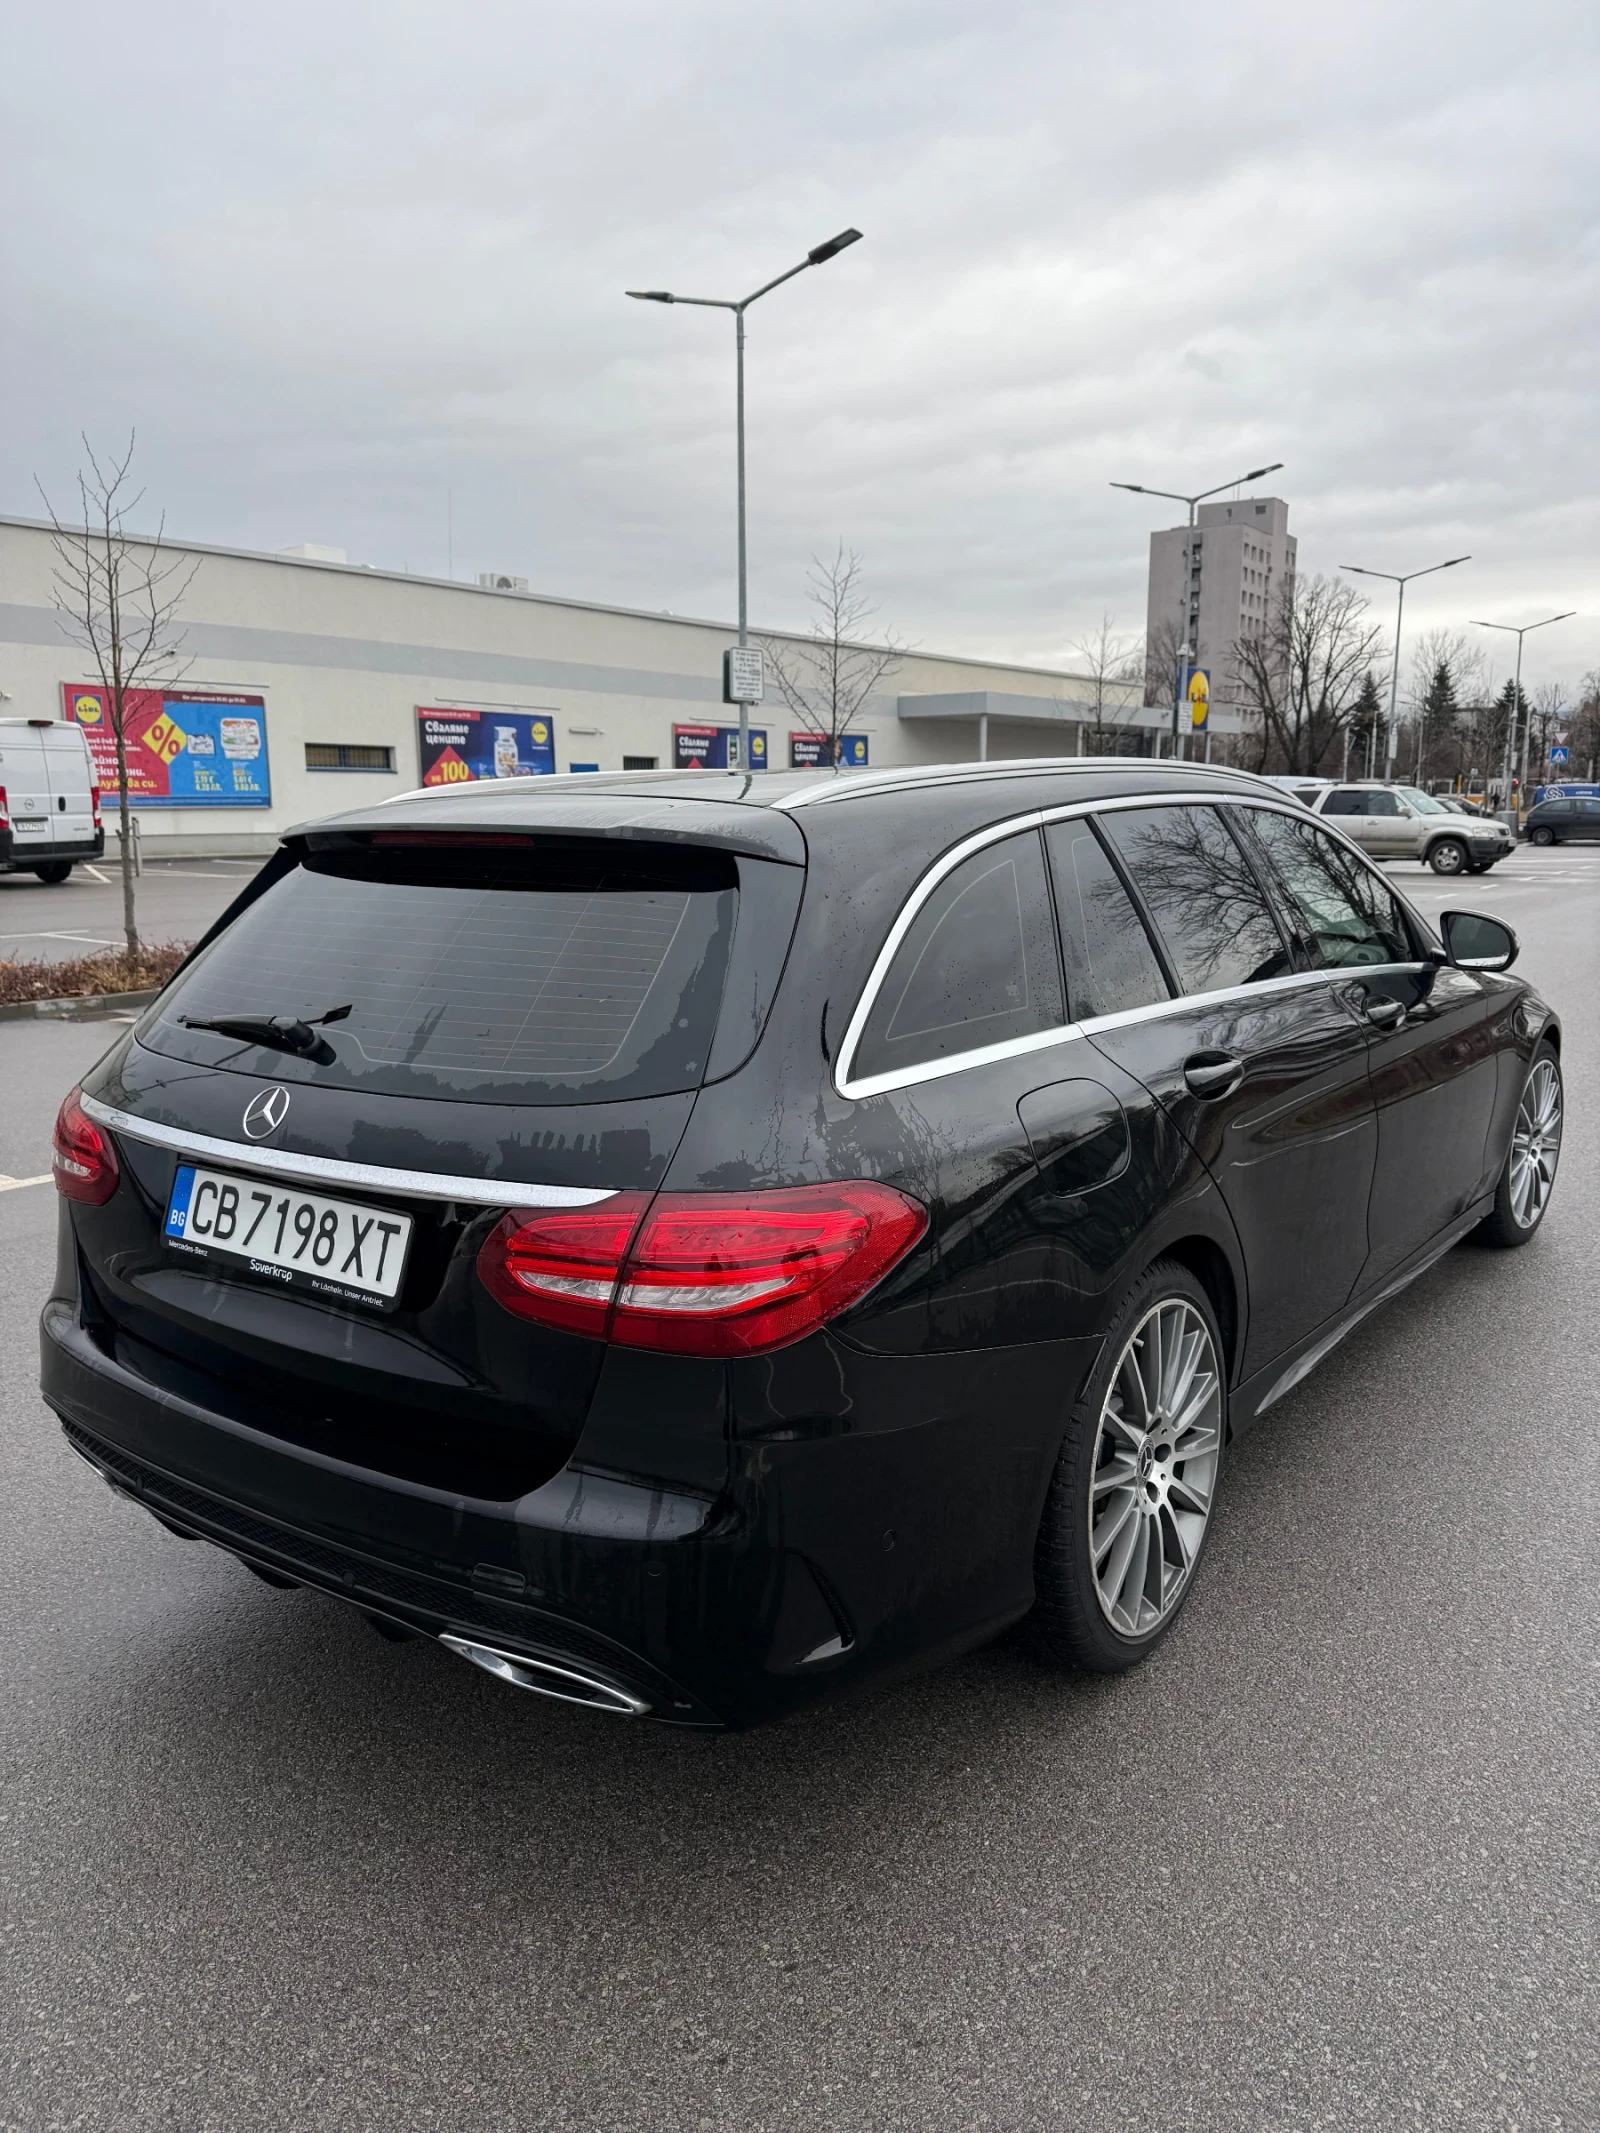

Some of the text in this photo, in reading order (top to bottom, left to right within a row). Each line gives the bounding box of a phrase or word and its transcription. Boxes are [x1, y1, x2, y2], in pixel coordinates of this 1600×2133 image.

[425, 720, 470, 734] Сваляме
[425, 734, 466, 746] цените
[96, 766, 114, 776] ски
[440, 761, 469, 782] 100
[169, 1209, 186, 1227] BG
[192, 1180, 402, 1282] CB 7198 XT
[168, 1239, 208, 1257] Mercedes-Benz
[311, 1280, 320, 1288] Ihr
[344, 1289, 361, 1300] Unser
